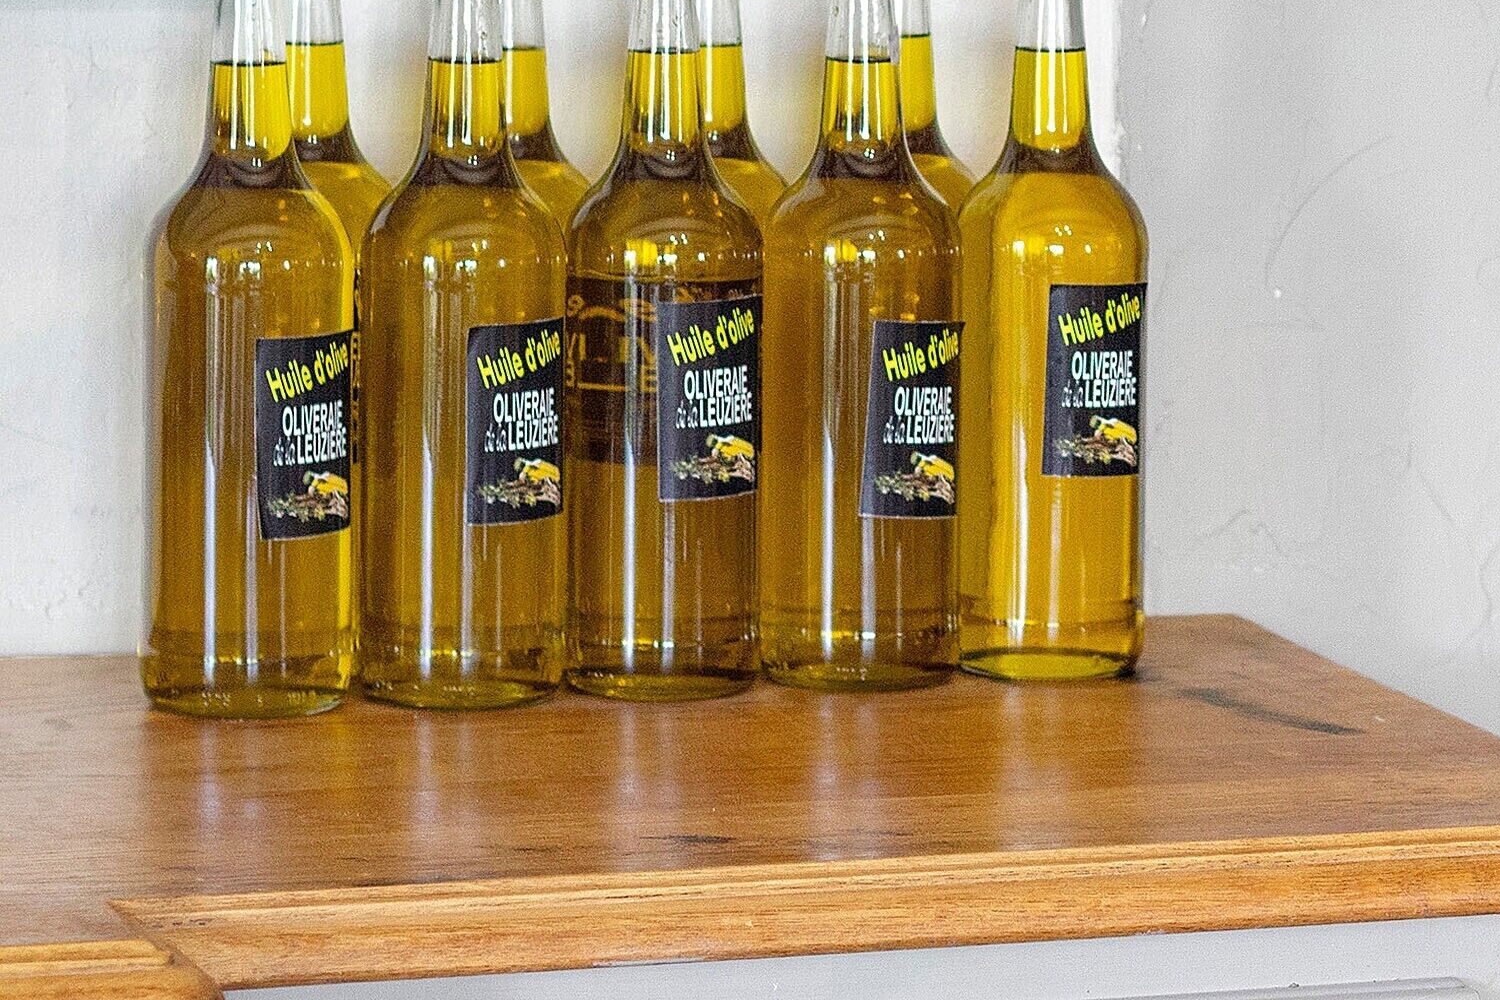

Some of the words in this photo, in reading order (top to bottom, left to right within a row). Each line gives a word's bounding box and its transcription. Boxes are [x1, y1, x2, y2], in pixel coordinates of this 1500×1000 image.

[667, 324, 715, 366] Huile
[716, 307, 755, 350] d'olive
[1058, 306, 1104, 346] Huile
[1105, 292, 1141, 333] d'olive
[266, 359, 313, 403] Huile
[314, 341, 348, 385] d'olive
[477, 346, 524, 389] Huile
[525, 329, 560, 372] d'olive
[882, 341, 926, 381] Huile
[928, 328, 959, 369] d'olive
[1071, 350, 1133, 380] OLIVERAIE
[493, 387, 555, 422] OLIVERAIE
[684, 365, 748, 400] OLIVERAIE
[894, 386, 953, 416] OLIVERAIE
[282, 399, 342, 437] OLIVERAIE
